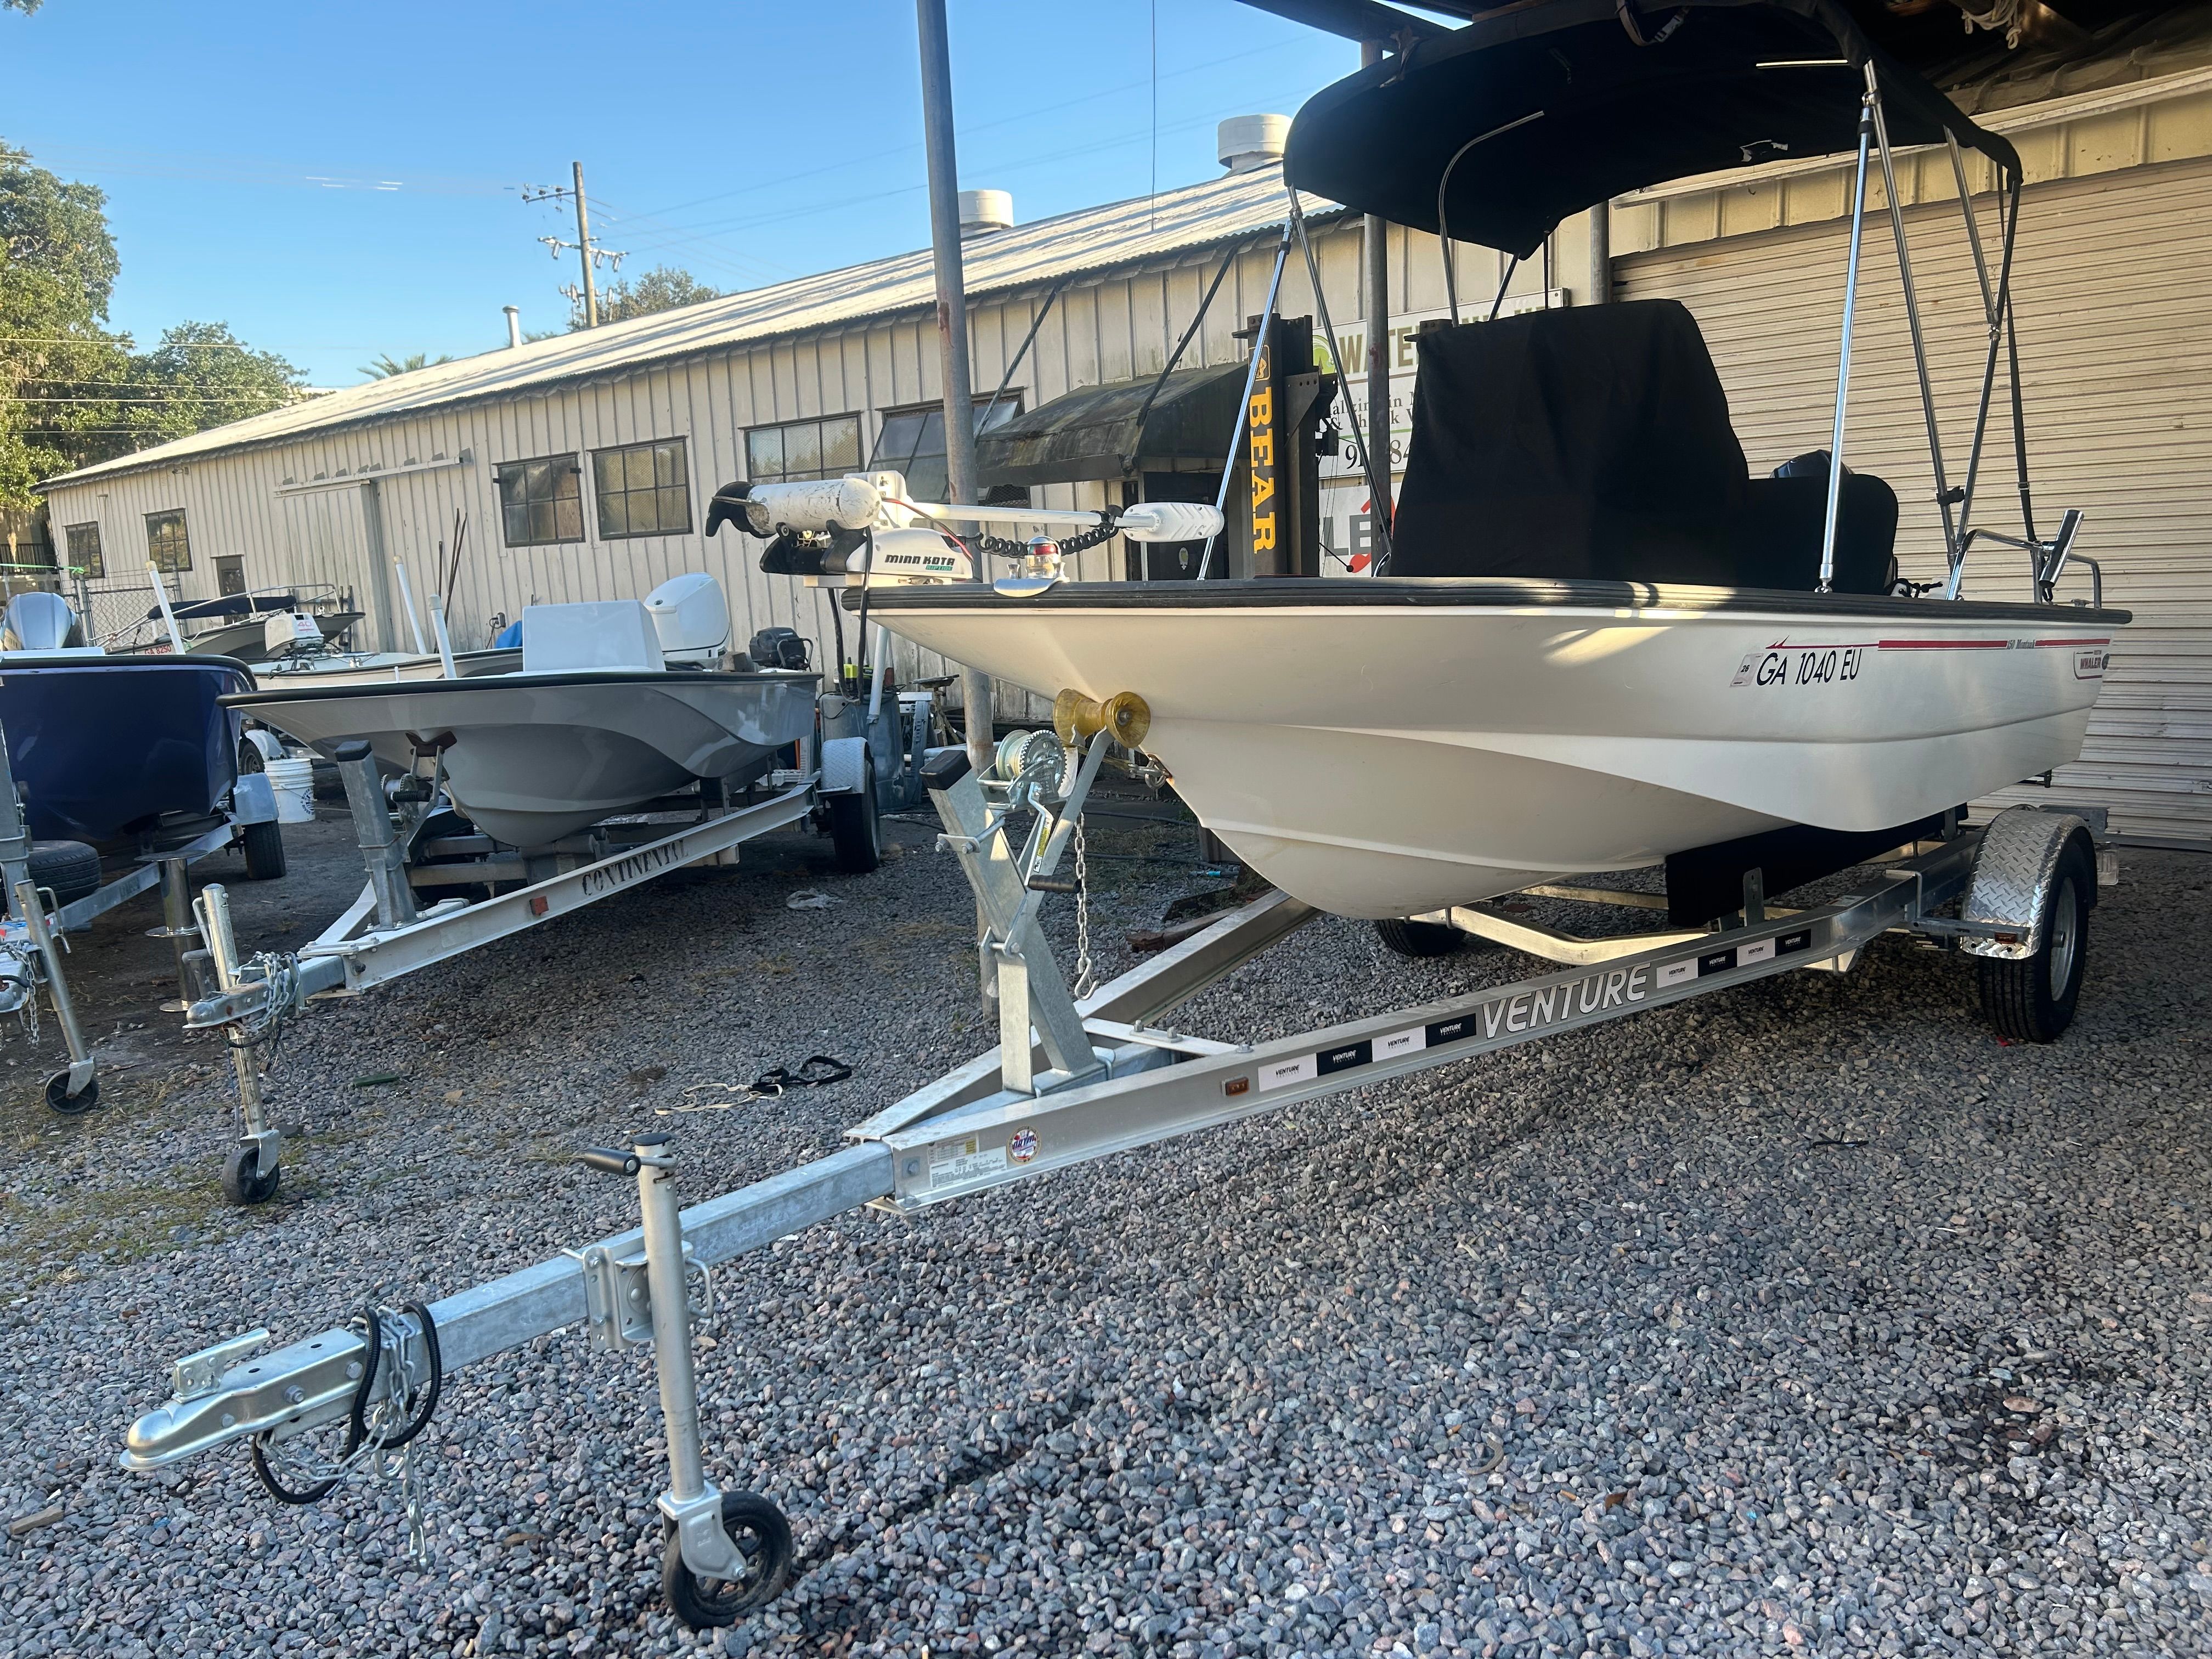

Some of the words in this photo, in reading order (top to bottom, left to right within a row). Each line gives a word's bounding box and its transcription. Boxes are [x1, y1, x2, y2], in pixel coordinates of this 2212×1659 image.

[1249, 386, 1276, 554] BEAR
[922, 556, 956, 566] KOTA
[156, 645, 172, 654] 8250
[1740, 664, 1750, 673] 26
[1757, 652, 1787, 686] GA
[1795, 651, 1836, 685] 1040
[1840, 648, 1863, 680] EU
[2080, 657, 2102, 669] WHALER
[1482, 963, 1650, 1039] VENTURE
[1440, 1023, 1462, 1034] VENTURE
[1387, 1036, 1410, 1047] VENTURE
[1333, 1050, 1356, 1061] VENTURE
[1276, 1064, 1300, 1075] VENTURE
